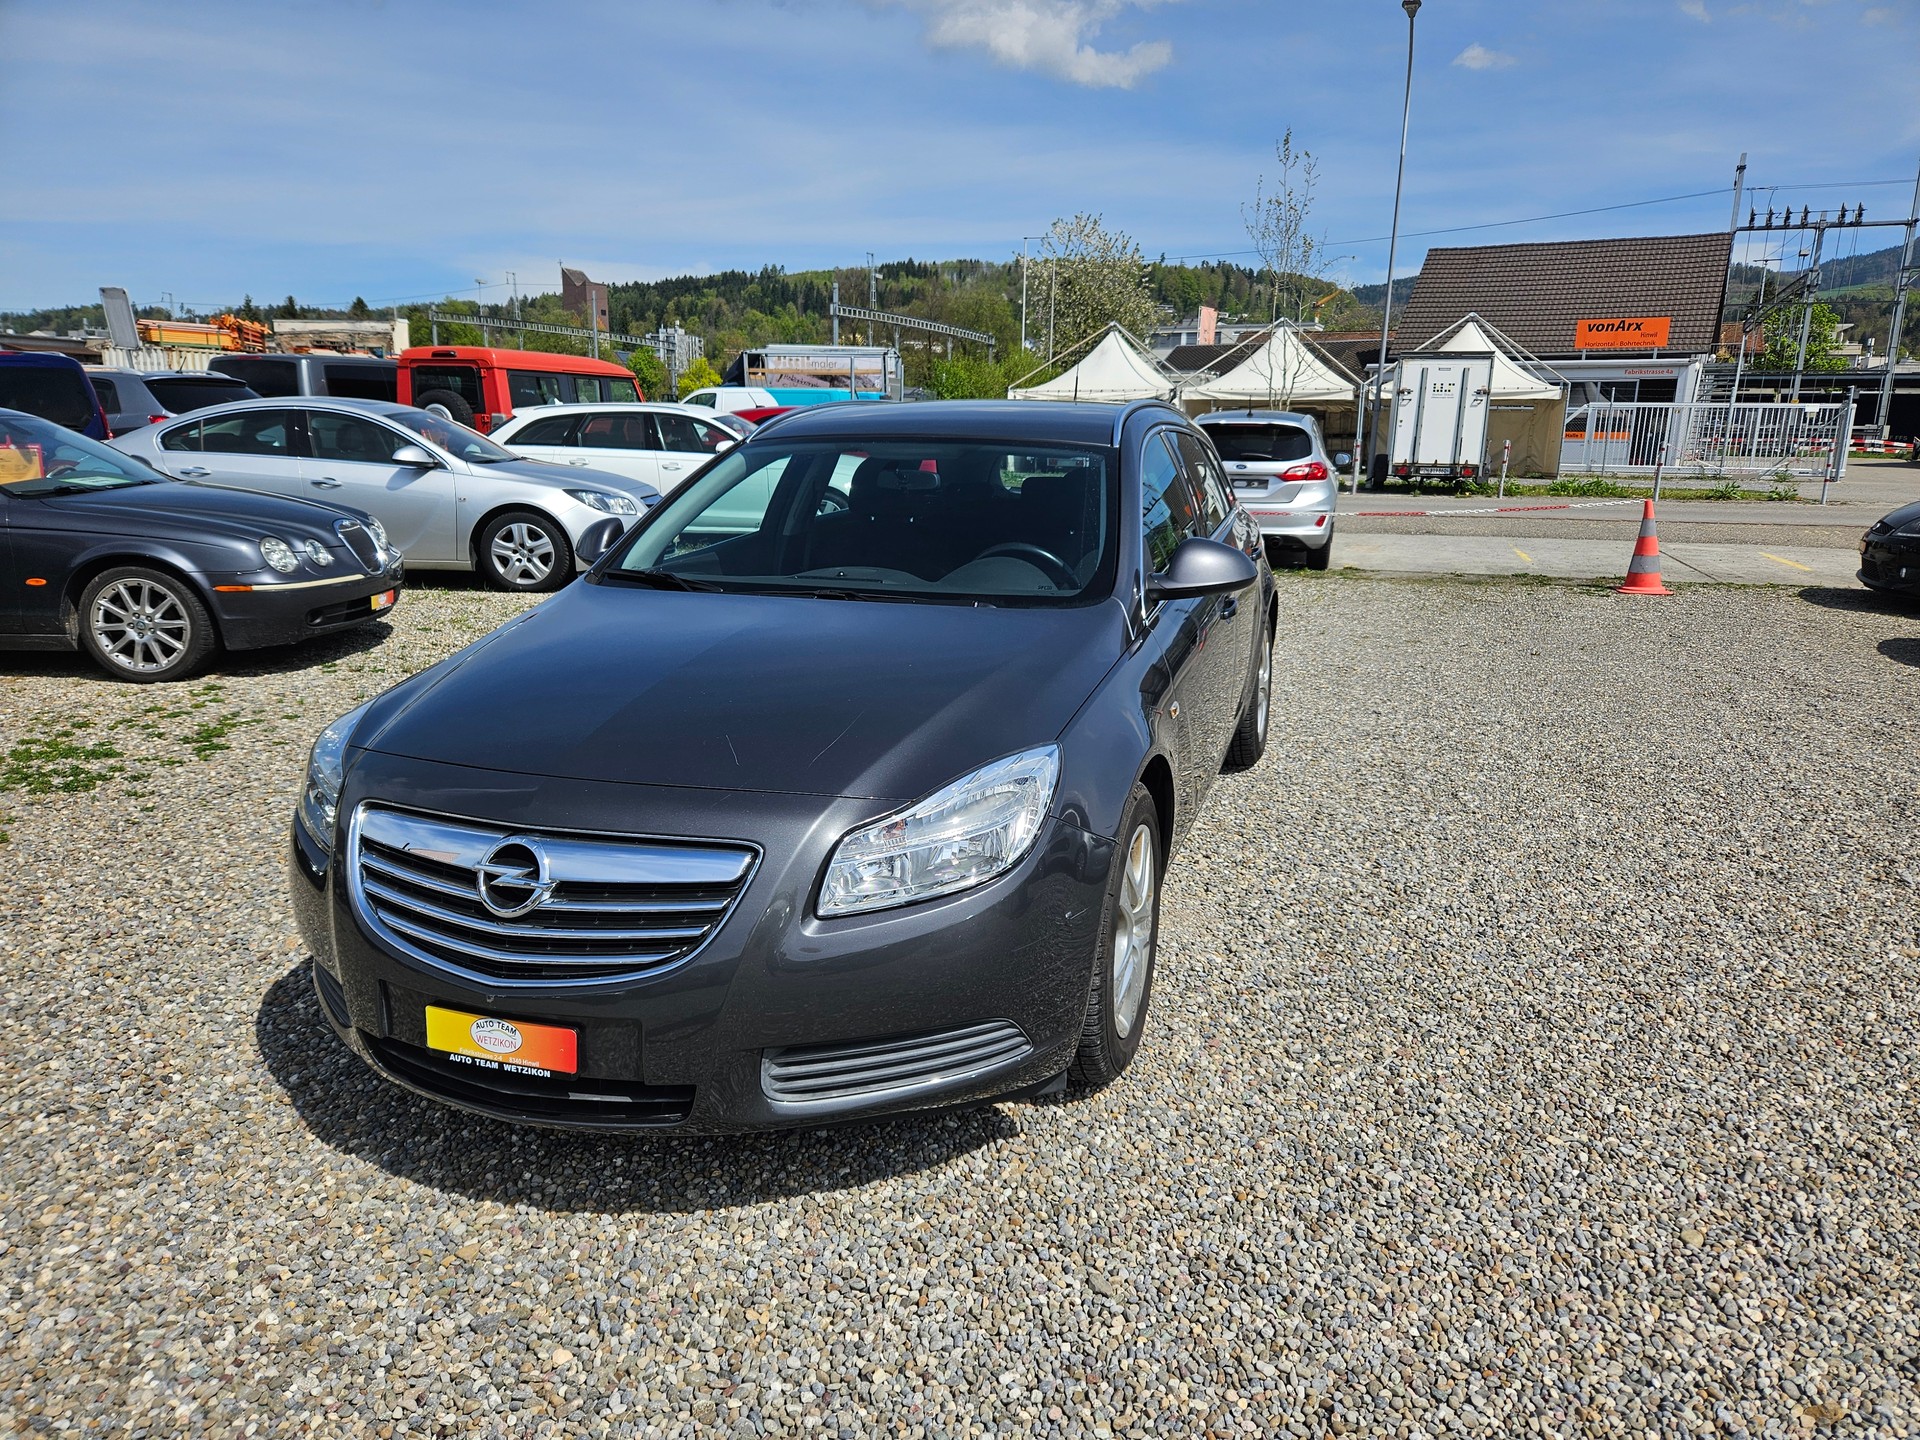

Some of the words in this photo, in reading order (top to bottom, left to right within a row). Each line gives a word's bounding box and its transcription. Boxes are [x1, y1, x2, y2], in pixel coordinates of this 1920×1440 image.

[1587, 319, 1644, 332] vonArx
[475, 1020, 495, 1029] AUTO
[496, 1021, 517, 1036] TEAM
[475, 1034, 517, 1049] WETZIKON
[459, 1047, 493, 1060] Fabrikstrasse
[509, 1056, 522, 1064] 8340
[449, 1054, 472, 1064] AUTO
[474, 1058, 499, 1069] TEAM
[503, 1063, 551, 1078] WETZIKON
